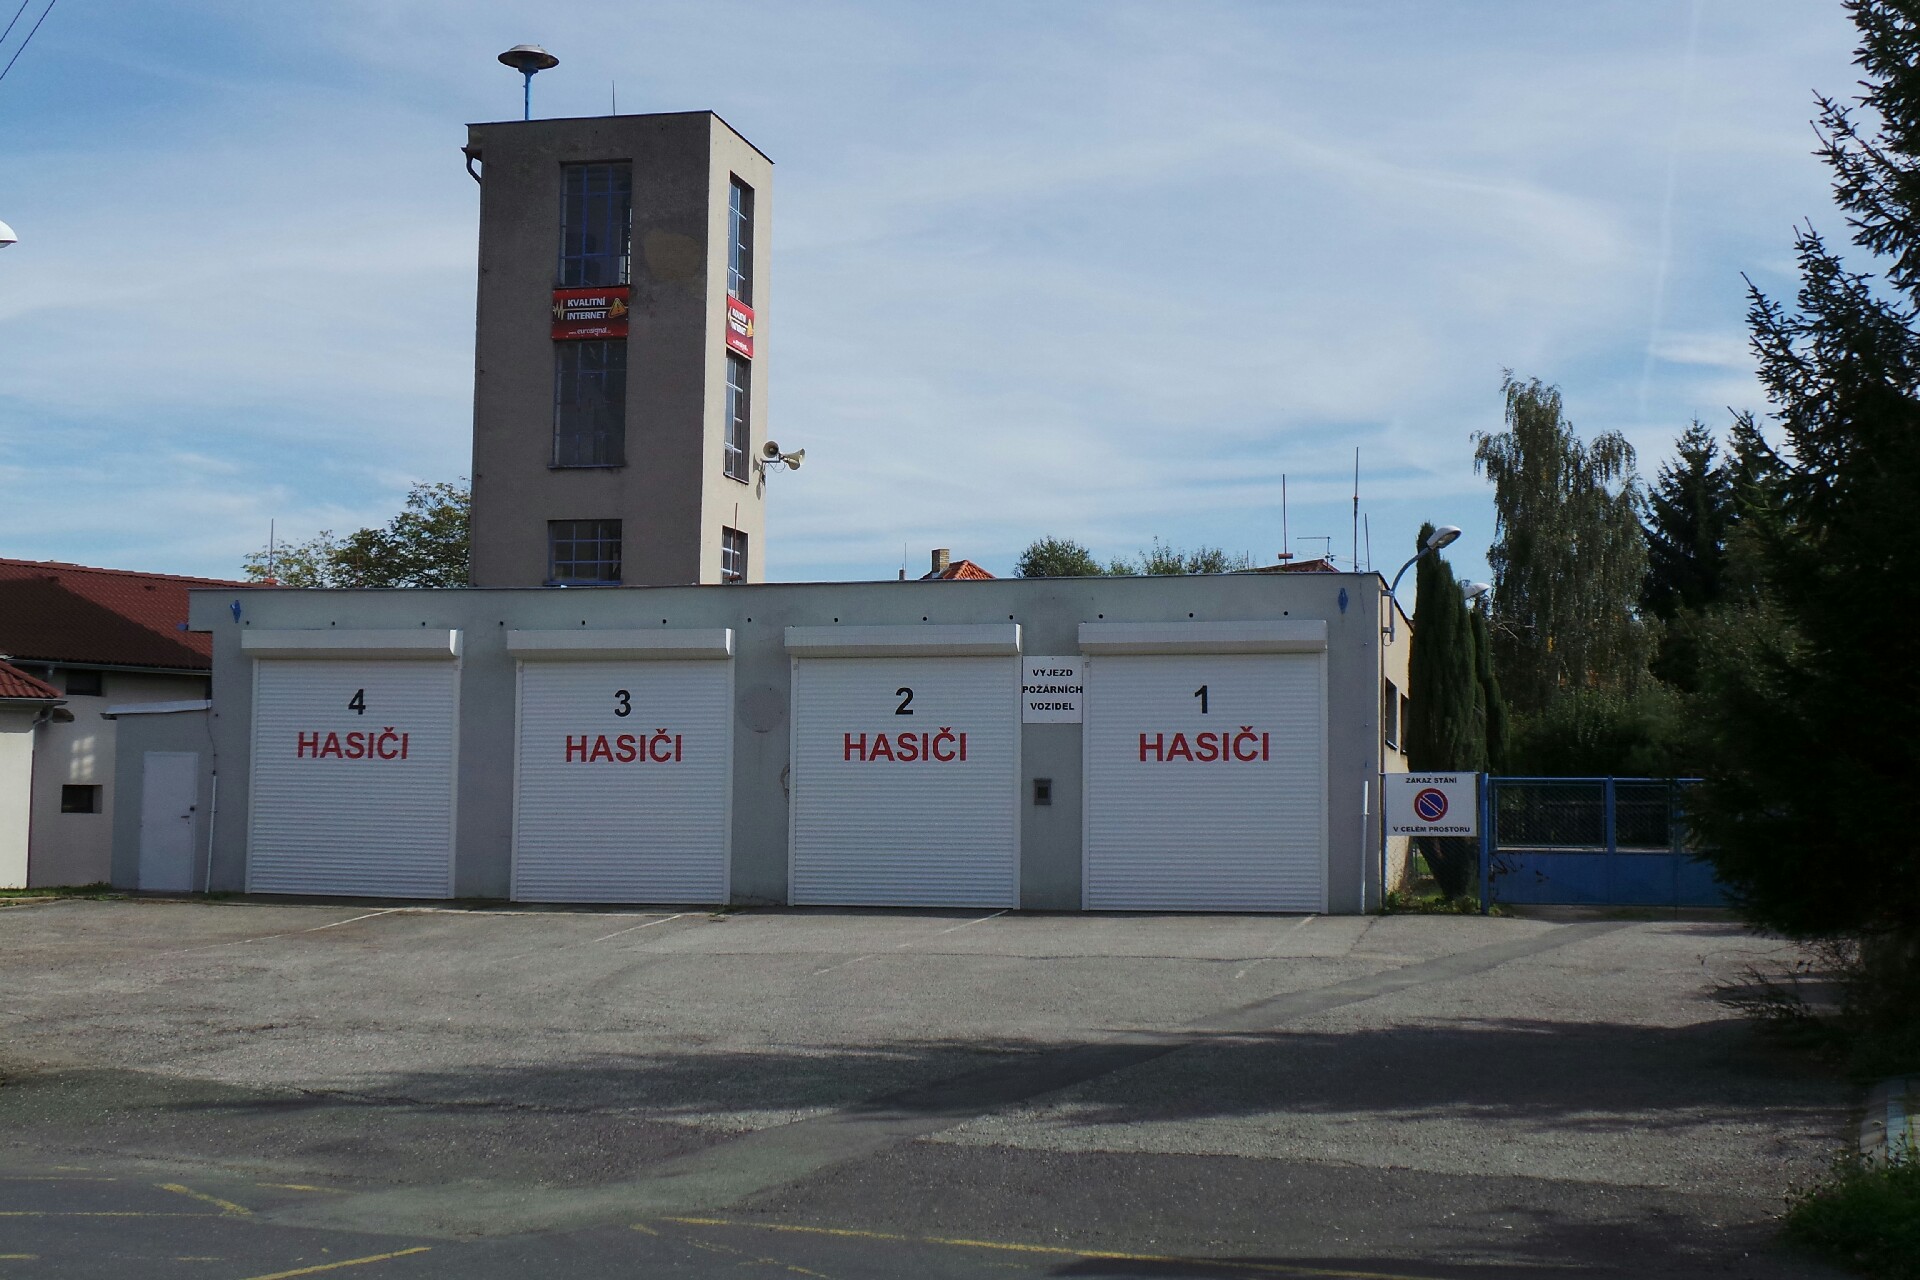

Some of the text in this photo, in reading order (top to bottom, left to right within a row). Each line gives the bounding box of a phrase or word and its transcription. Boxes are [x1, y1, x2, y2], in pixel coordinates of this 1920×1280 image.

[567, 296, 606, 307] KVALITNÍ
[567, 311, 607, 320] INTERNET
[1032, 667, 1073, 677] VÝJEZD
[347, 688, 367, 715] 4
[894, 688, 914, 715] 2
[1022, 683, 1084, 694] POŽÁRNÍCH
[1194, 685, 1208, 714] 1
[614, 690, 632, 717] 3
[1030, 702, 1075, 711] VOZIDEL
[297, 727, 408, 760] HASIČI
[566, 729, 682, 762] HASIČI
[844, 727, 967, 762] HASIČI
[1140, 726, 1269, 762] HASIČI
